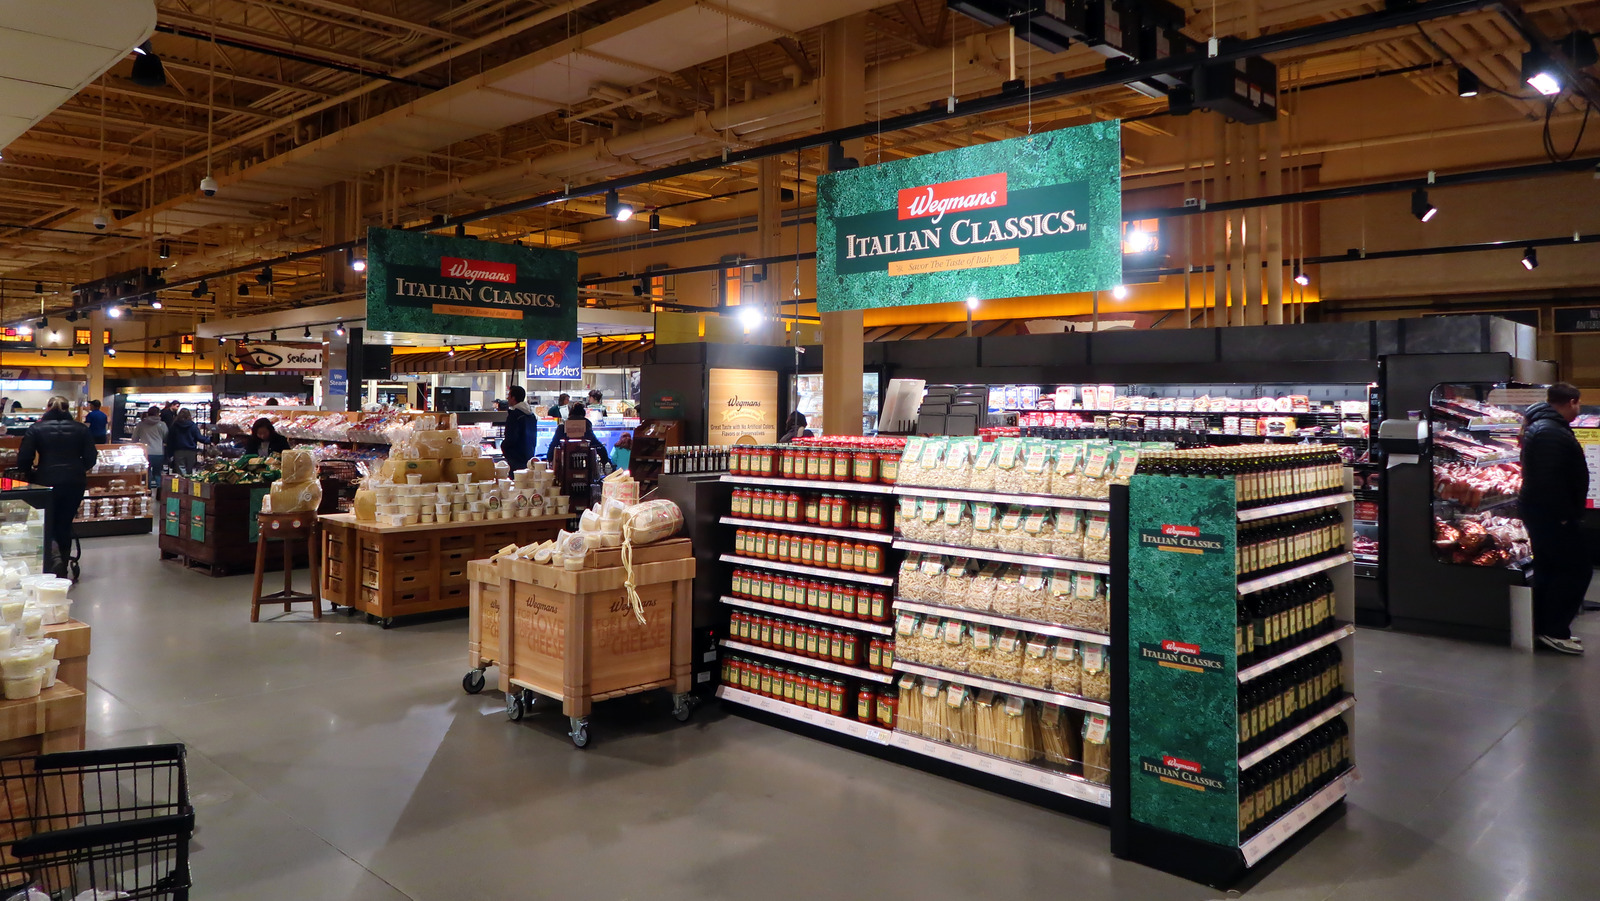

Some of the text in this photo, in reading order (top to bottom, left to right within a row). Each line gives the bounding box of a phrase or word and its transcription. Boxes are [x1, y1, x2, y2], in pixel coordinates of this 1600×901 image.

[907, 187, 997, 225] Wegmans
[846, 227, 942, 259] ITALIAN
[447, 260, 510, 285] Wegmans
[907, 254, 994, 271] Savor The Taste of Italy
[396, 277, 473, 301] ITALIAN
[287, 353, 317, 363] Seafood
[528, 363, 580, 377] Live Lobsters
[727, 395, 761, 411] Wegmans
[1142, 533, 1221, 549] ITALIAN CLASSICS
[1166, 525, 1196, 538] Wegmans
[526, 594, 558, 615] Wegmans
[531, 613, 564, 638] LOVE
[528, 631, 564, 660] CHEESE
[612, 631, 665, 655] CHEESE
[1166, 641, 1196, 654] Wegmans
[1142, 647, 1221, 669] ITALIAN CLASSICS
[1143, 761, 1223, 788] ITALIAN CLASSICS
[1167, 758, 1198, 771] Wegmans
